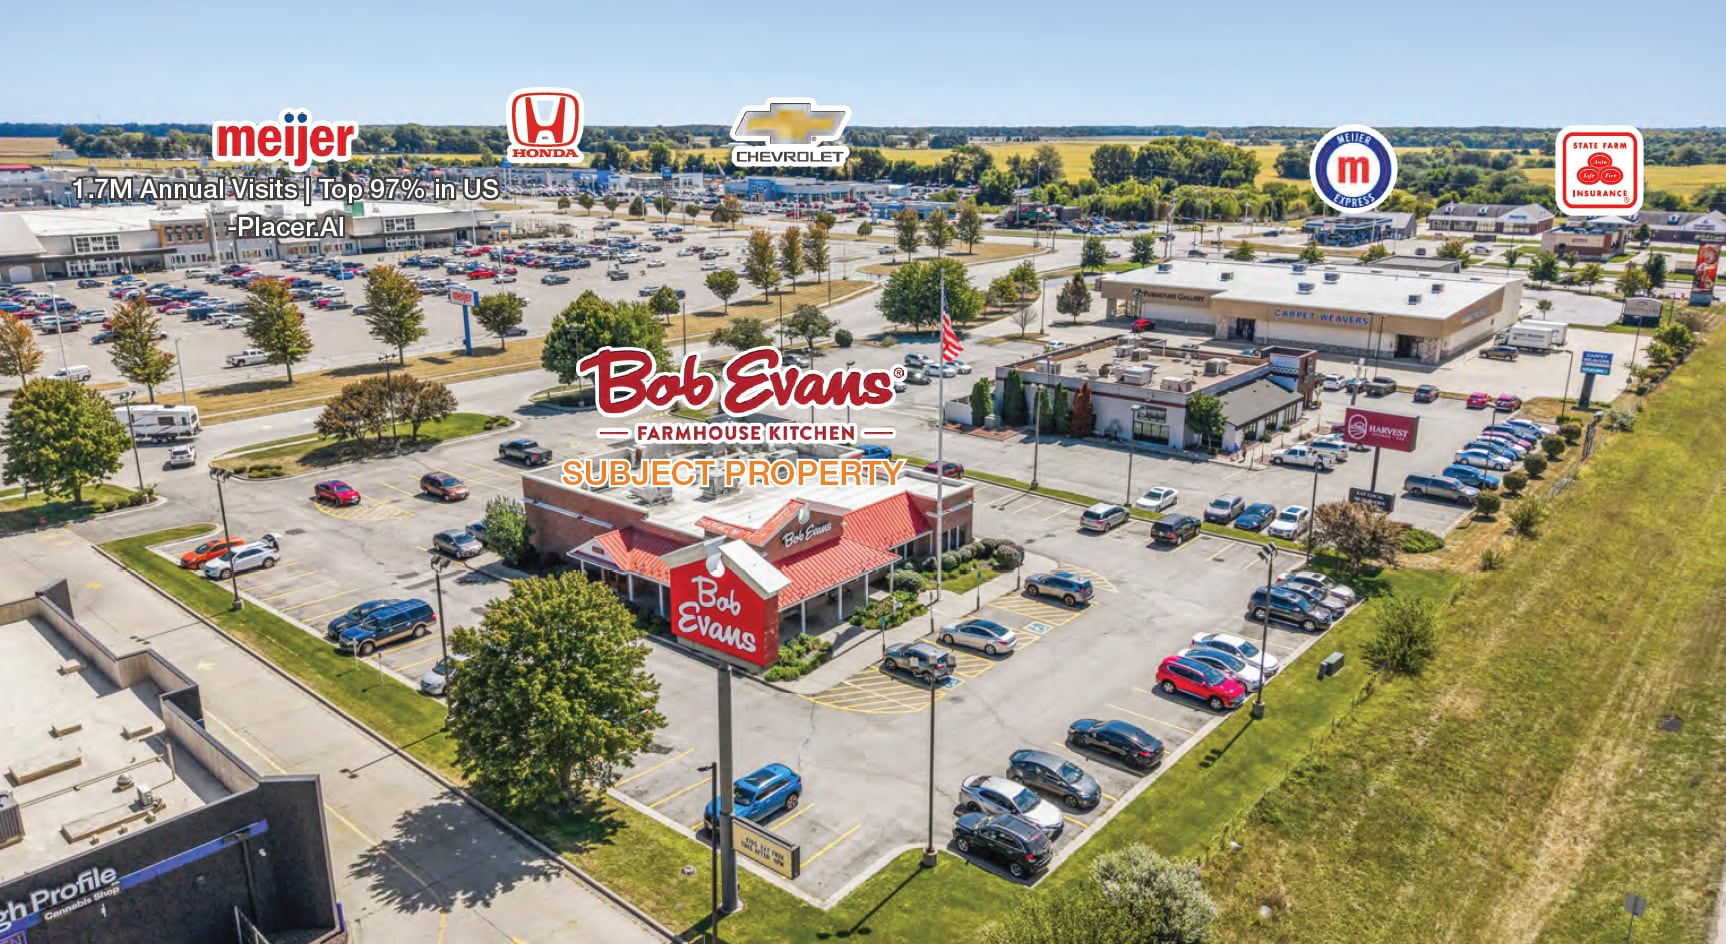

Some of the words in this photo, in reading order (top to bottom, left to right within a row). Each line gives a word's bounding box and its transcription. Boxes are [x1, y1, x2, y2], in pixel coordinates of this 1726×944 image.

[1274, 309, 1315, 319] CARPET
[1320, 313, 1368, 325] WEAVERS
[1369, 425, 1409, 438] HARVEST
[781, 530, 804, 548] Bob
[805, 522, 832, 540] Evans
[691, 575, 741, 616] Bob
[678, 601, 756, 652] Evans
[30, 867, 117, 914] Profile
[44, 896, 93, 920] Cannabis
[93, 887, 120, 902] Shop
